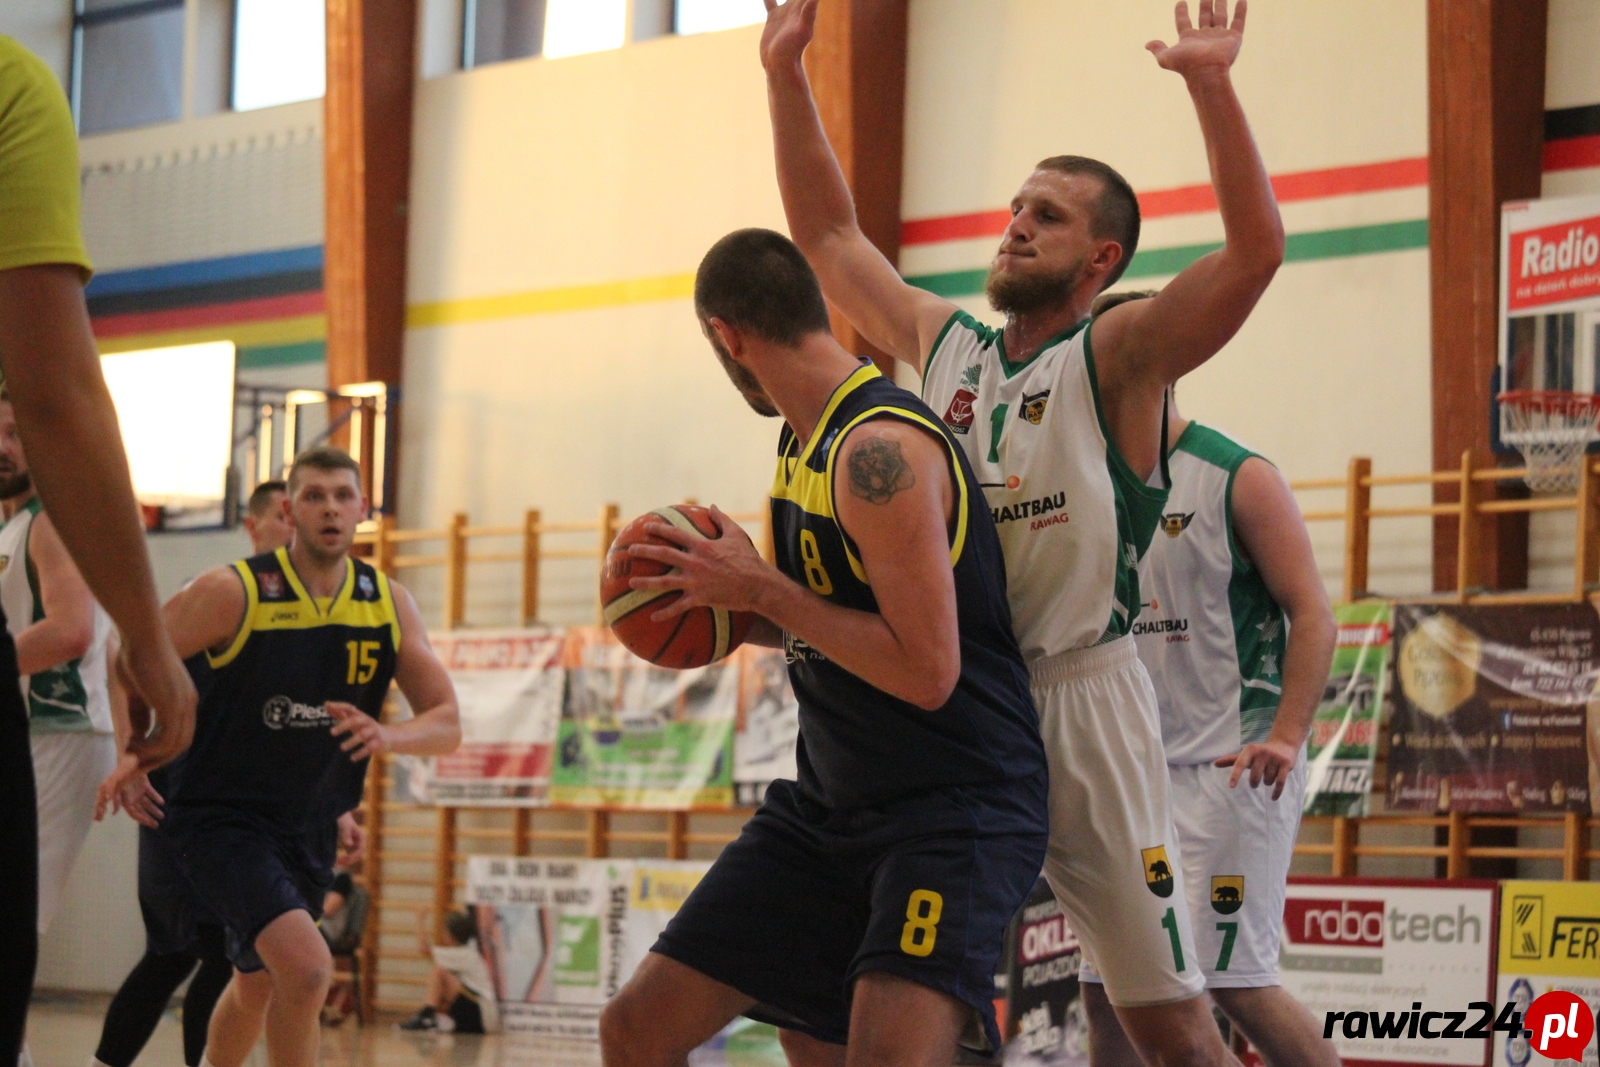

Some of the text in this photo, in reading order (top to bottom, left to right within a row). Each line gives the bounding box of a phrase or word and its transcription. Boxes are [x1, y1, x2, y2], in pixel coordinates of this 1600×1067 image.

[1521, 226, 1599, 279] Radio
[987, 403, 1009, 463] 1
[1030, 512, 1069, 531] RAWAG
[800, 529, 833, 595] 8
[345, 640, 381, 684] 15
[900, 889, 943, 957] 8
[1161, 907, 1186, 973] 1
[1215, 922, 1238, 971] 7
[1303, 899, 1482, 945] robotech
